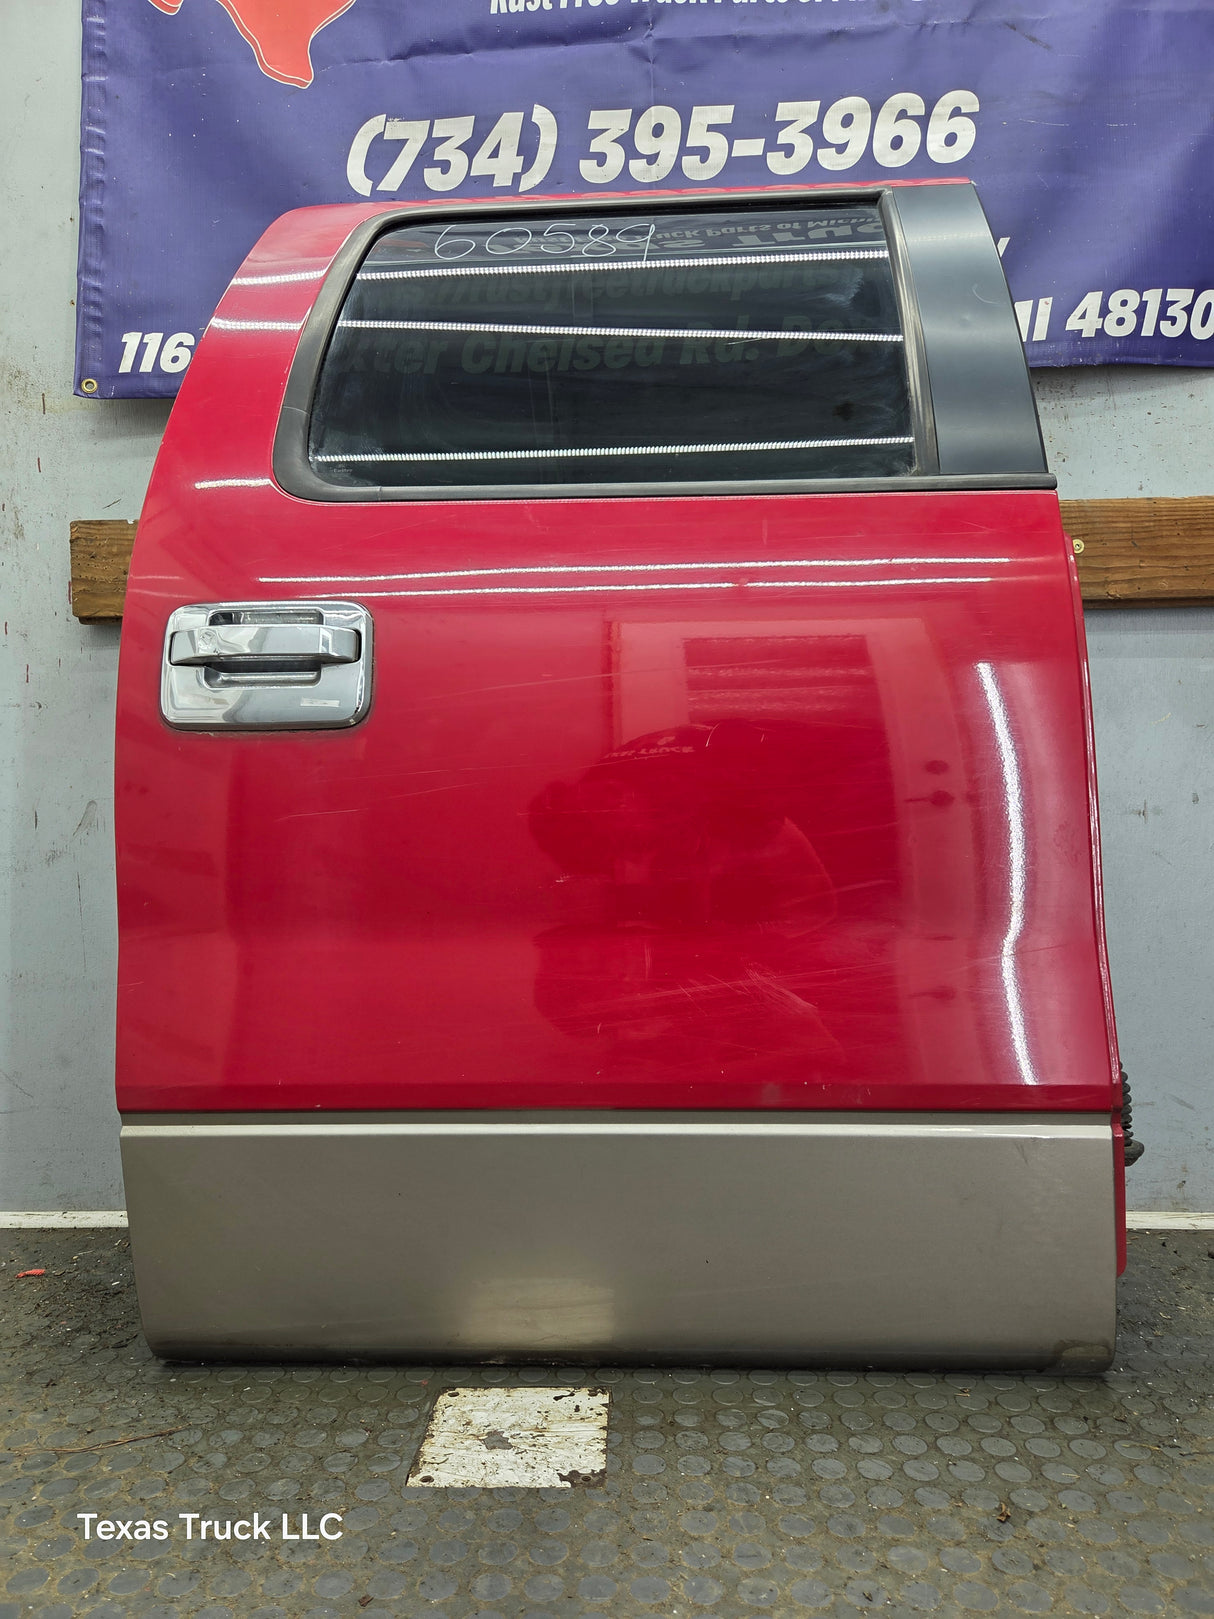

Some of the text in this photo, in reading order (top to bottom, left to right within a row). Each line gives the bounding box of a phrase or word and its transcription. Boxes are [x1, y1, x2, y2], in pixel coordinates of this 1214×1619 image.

[346, 90, 980, 197] (734) 395-3966
[434, 223, 656, 261] 60589
[461, 326, 666, 375] Chelsea
[679, 314, 760, 366] Rd.
[1065, 288, 1214, 341] 48130
